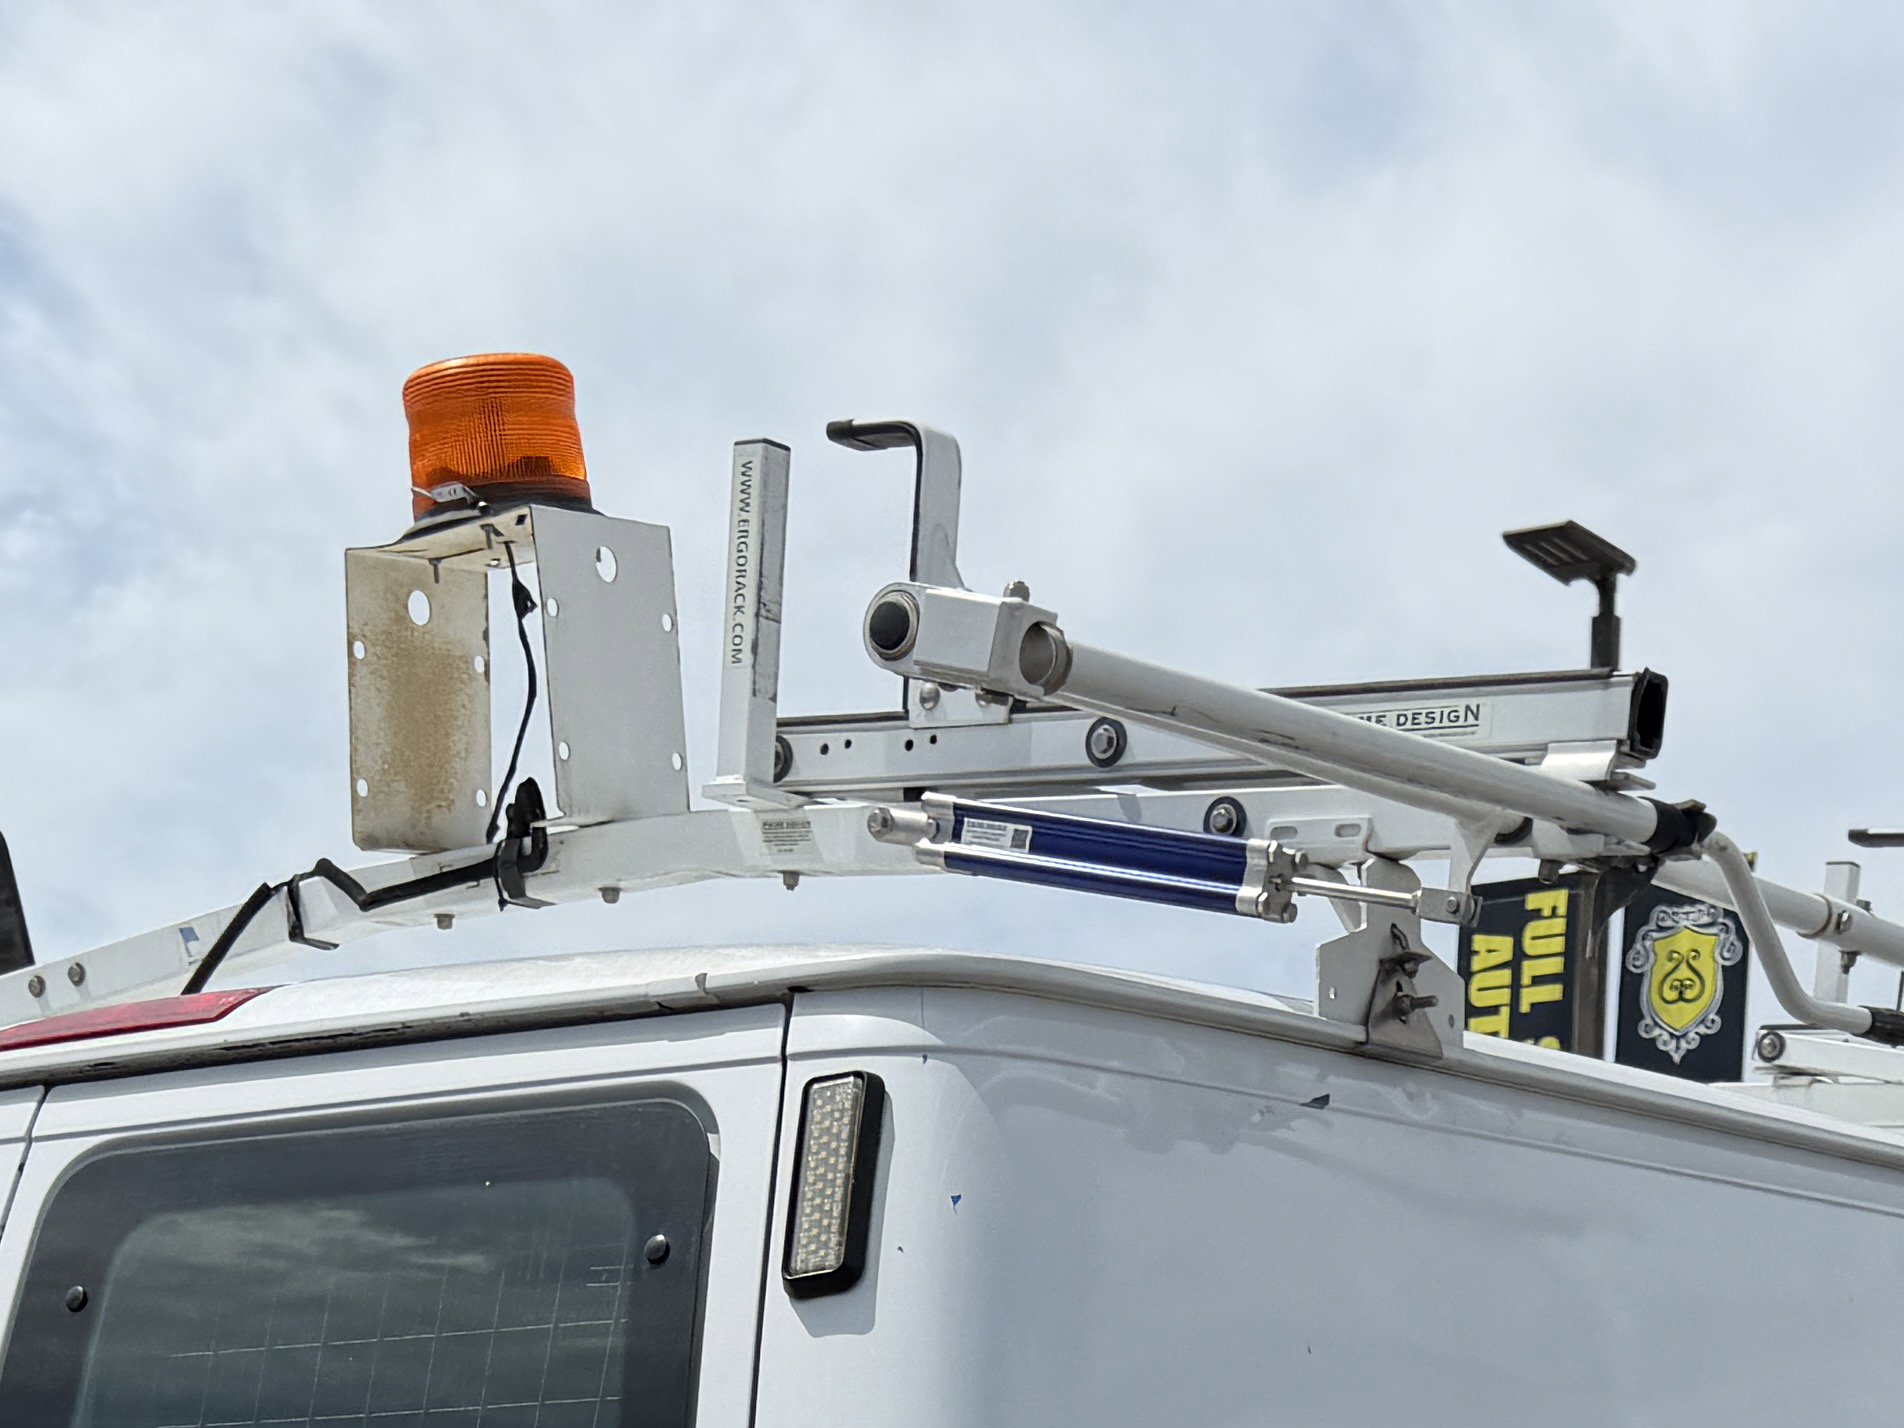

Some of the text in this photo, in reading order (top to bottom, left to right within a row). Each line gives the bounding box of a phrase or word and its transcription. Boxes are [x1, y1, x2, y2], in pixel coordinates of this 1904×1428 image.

[730, 459, 754, 665] WWW.ERGORACK.COM
[1395, 703, 1482, 728] DESIGN
[1467, 933, 1515, 1040] AUT
[1518, 888, 1569, 1014] FULL
